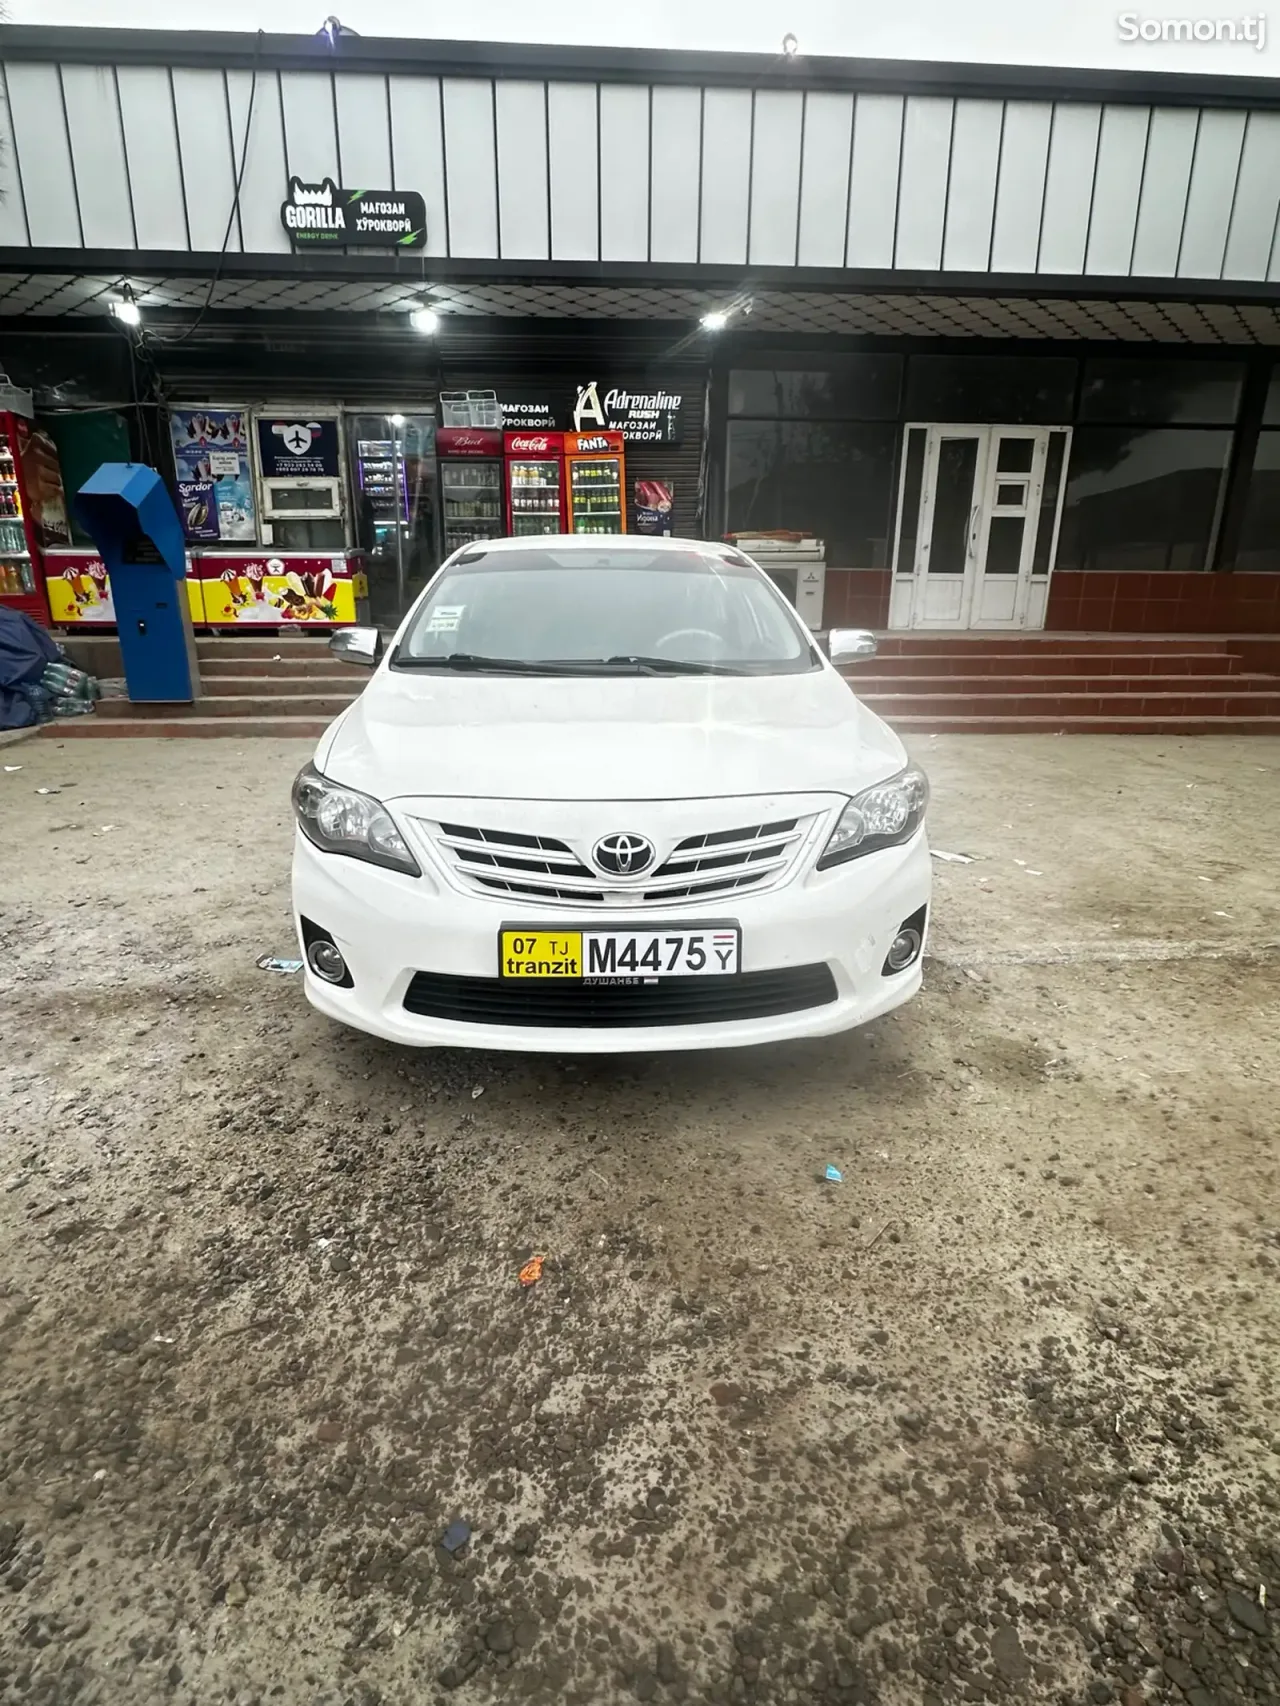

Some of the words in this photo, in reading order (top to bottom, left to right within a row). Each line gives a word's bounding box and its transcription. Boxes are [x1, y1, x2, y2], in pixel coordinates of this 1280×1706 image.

[285, 205, 346, 228] GORILLA
[604, 389, 681, 417] Adrenaline
[628, 410, 660, 419] RUSH
[577, 437, 608, 450] FANTA
[179, 482, 212, 497] Sardor
[513, 938, 537, 954] 07
[549, 941, 568, 955] TJ
[589, 936, 707, 973] M4475
[507, 957, 577, 974] tranzit
[714, 949, 733, 970] Y
[583, 977, 640, 985] ДУШАНБЕ
